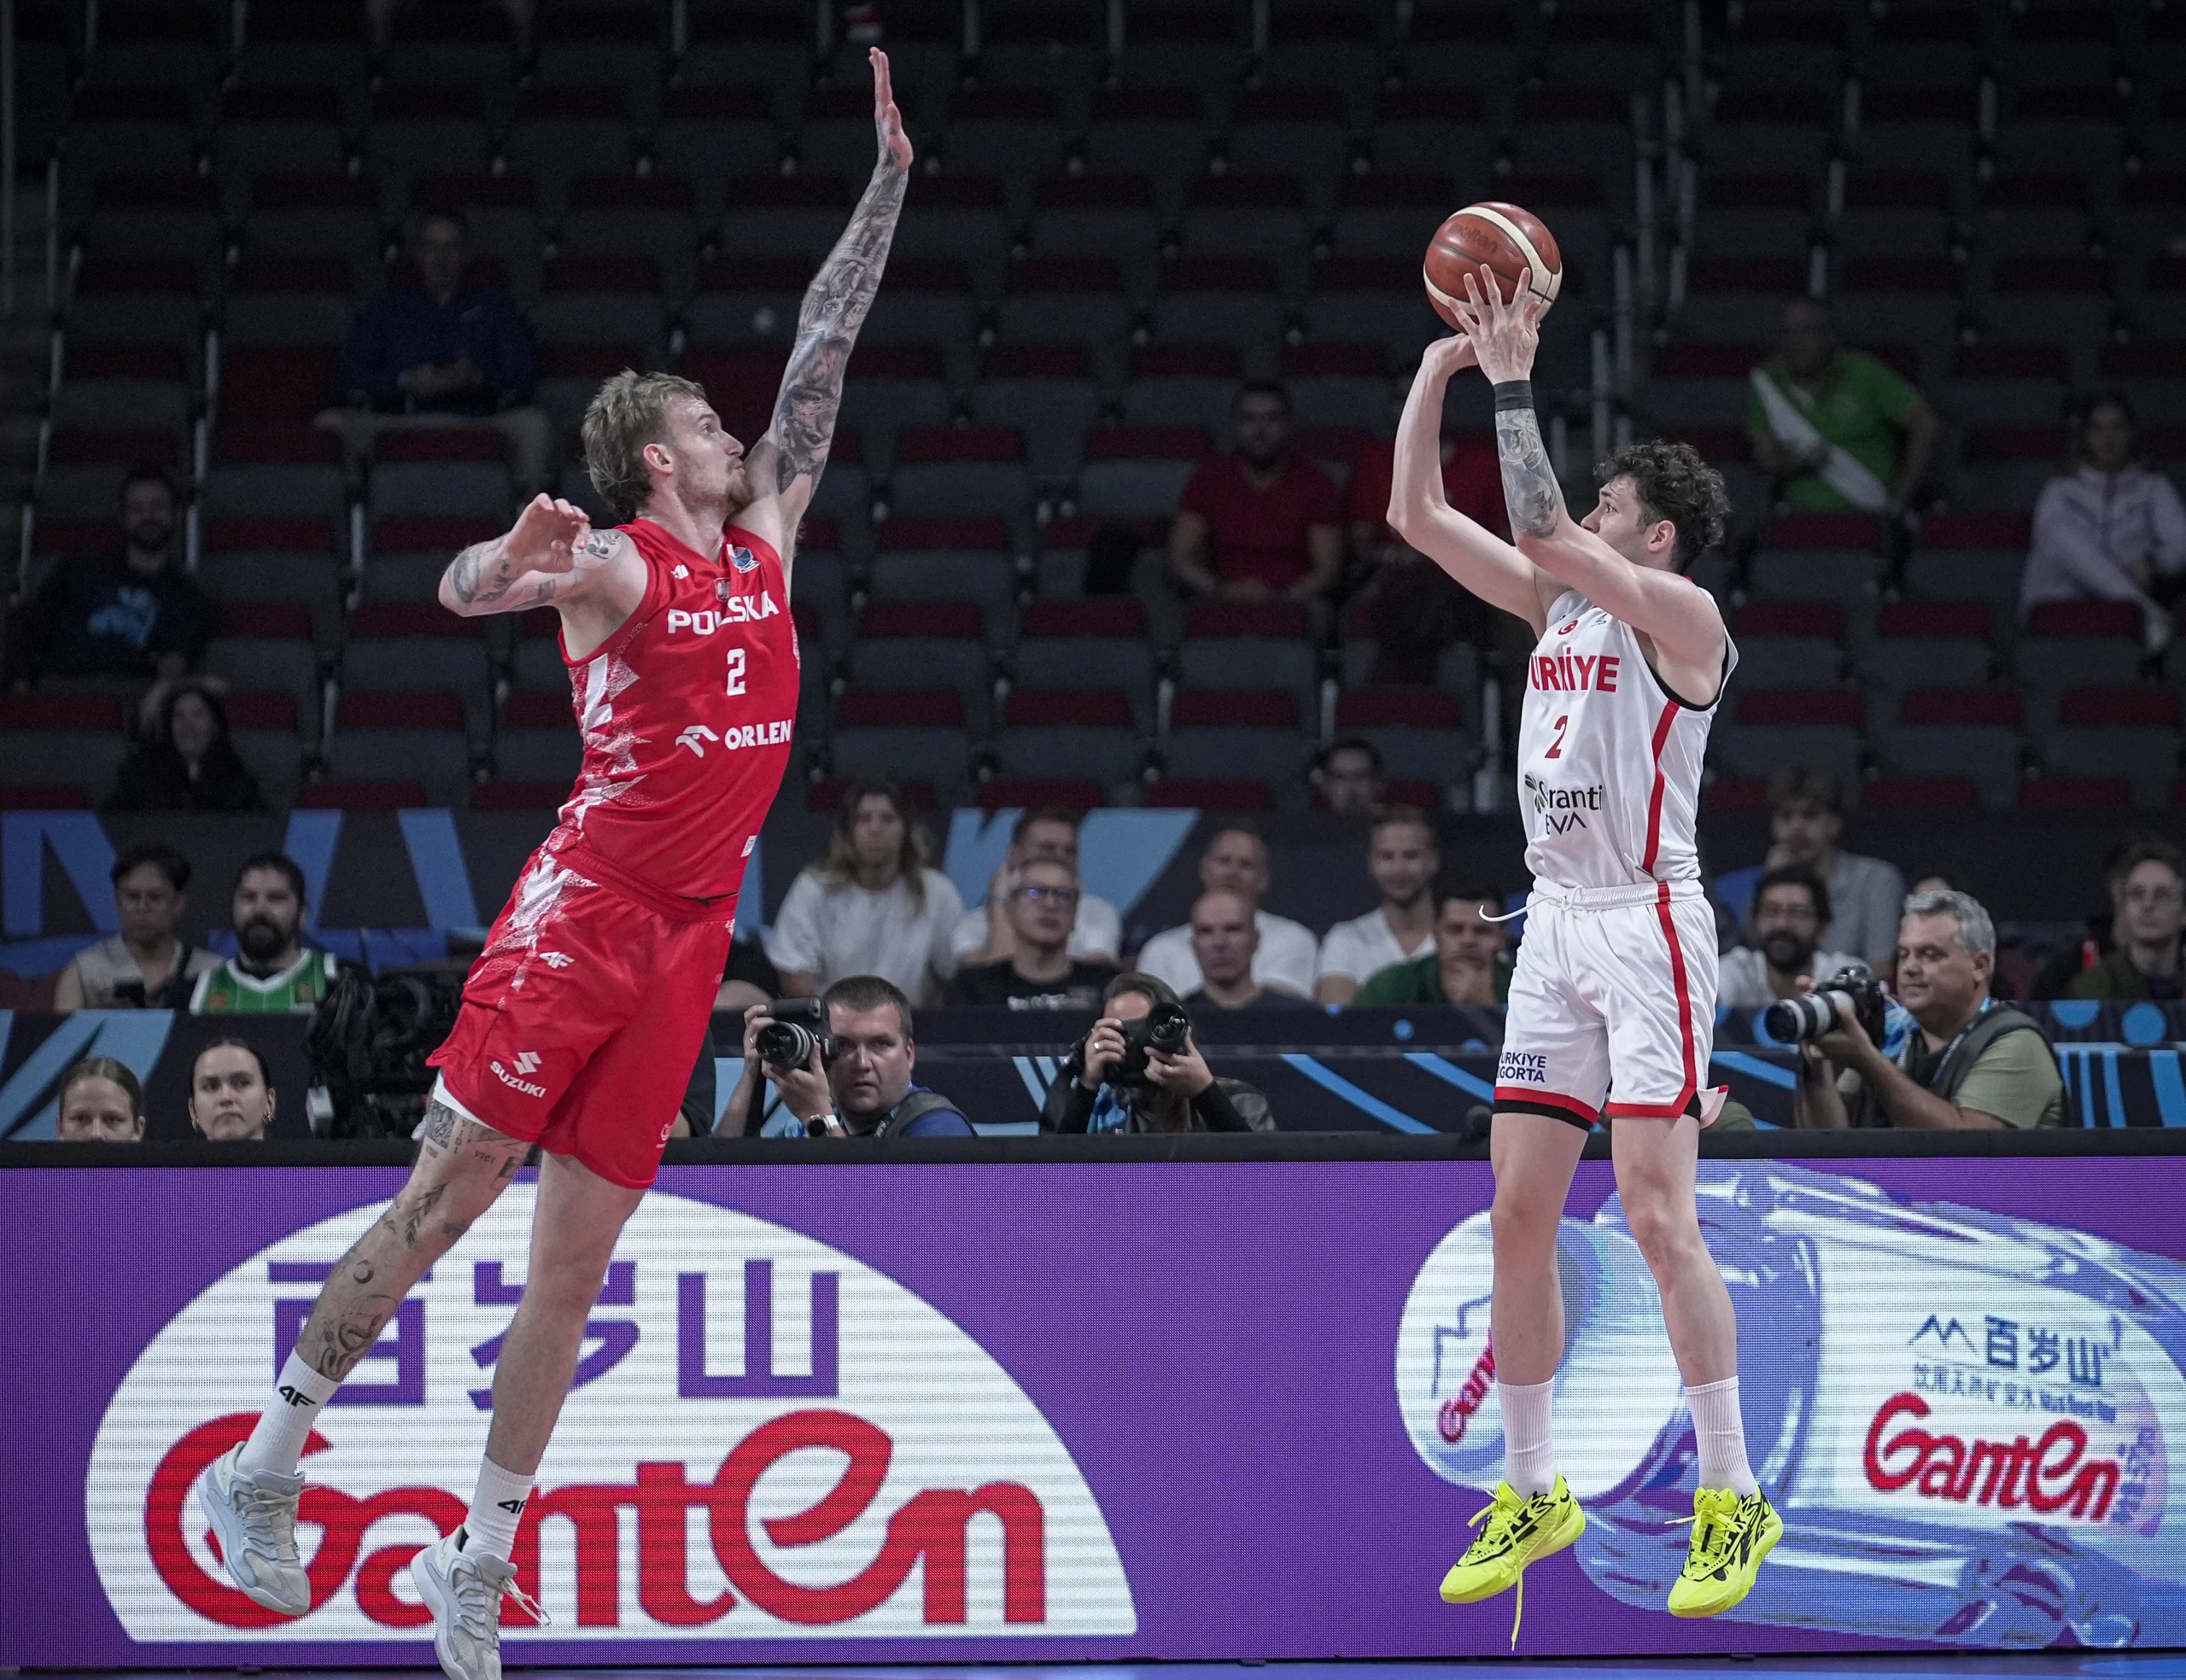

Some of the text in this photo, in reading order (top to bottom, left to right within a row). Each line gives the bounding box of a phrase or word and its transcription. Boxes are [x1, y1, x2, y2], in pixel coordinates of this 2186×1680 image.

[667, 590, 780, 635] POLSKA
[727, 648, 746, 697] 2
[725, 720, 792, 750] ORLEN
[1544, 715, 1569, 759] 2
[489, 1060, 546, 1099] SUZUKI
[1499, 1065, 1546, 1083] GORTA
[266, 1259, 840, 1410] 百岁山
[1984, 1315, 2103, 1385] 百岁山
[278, 1385, 316, 1408] 4F
